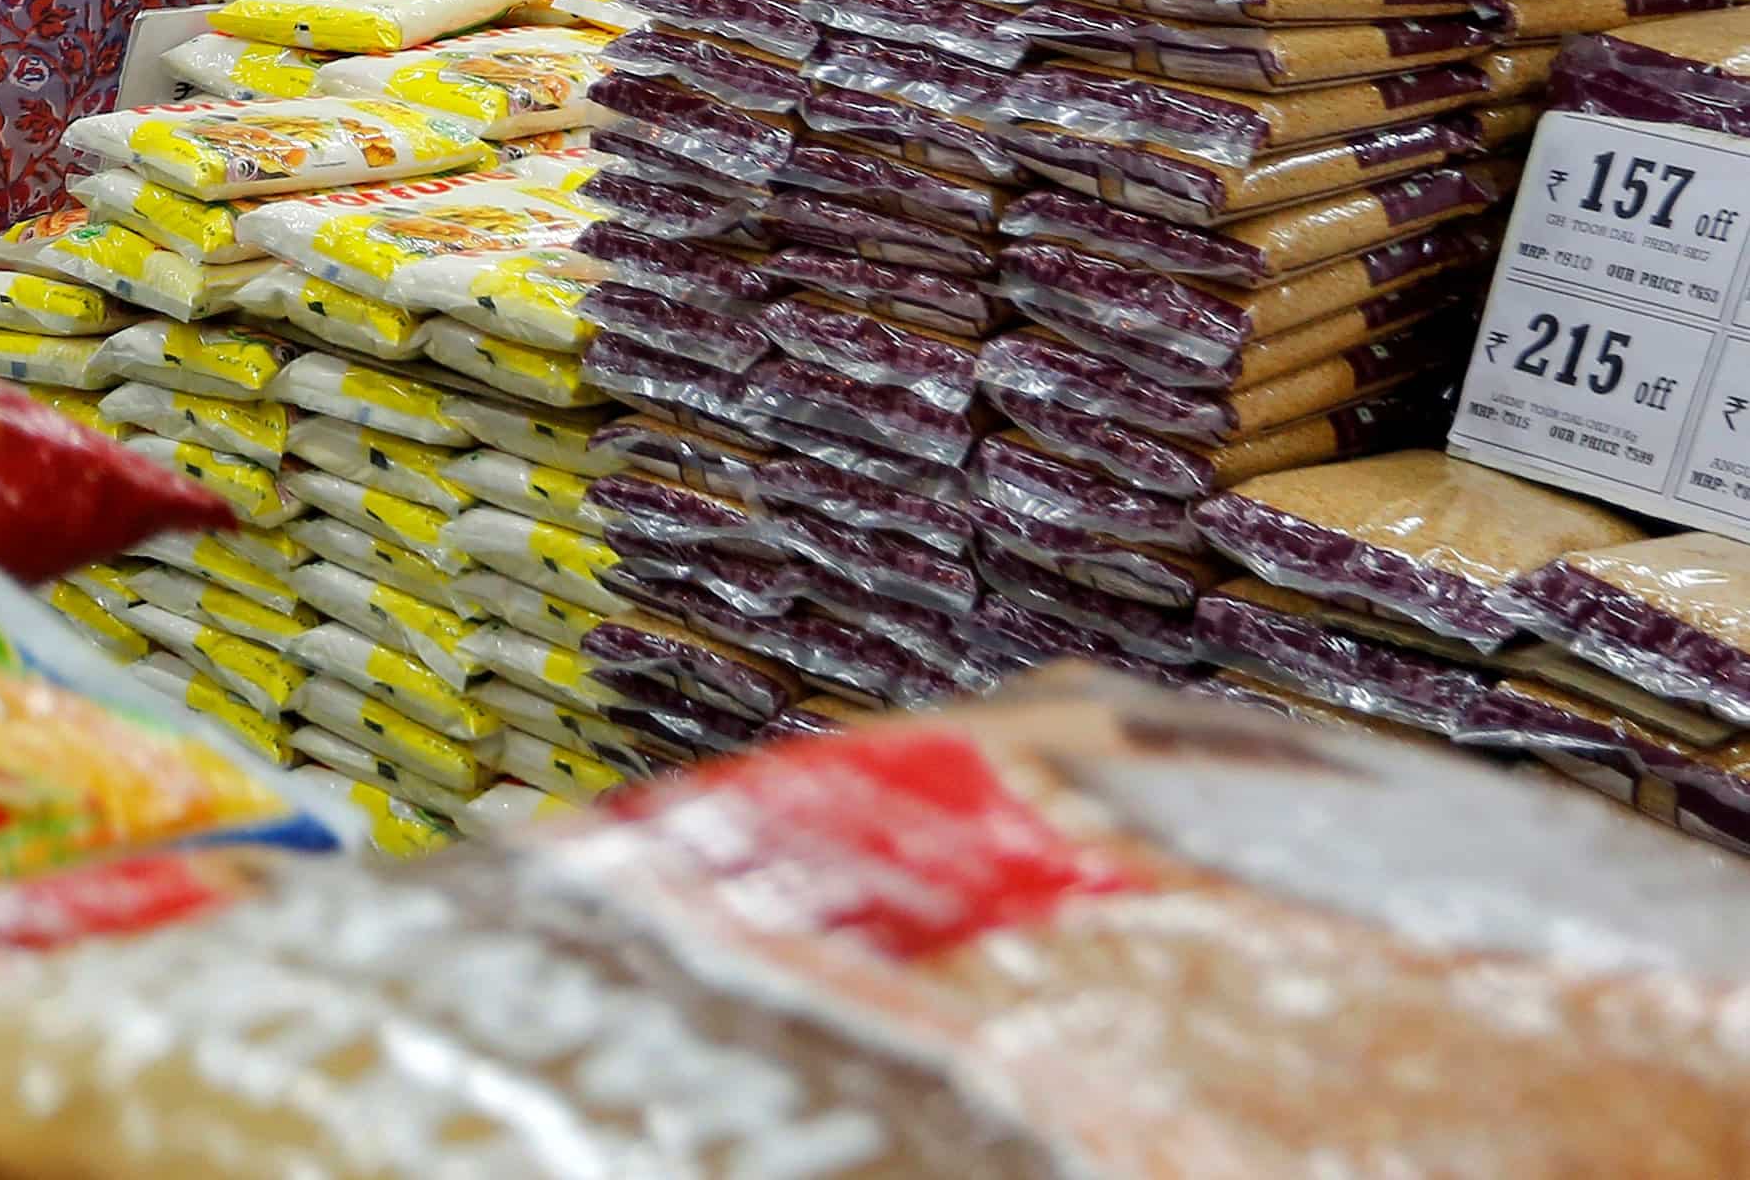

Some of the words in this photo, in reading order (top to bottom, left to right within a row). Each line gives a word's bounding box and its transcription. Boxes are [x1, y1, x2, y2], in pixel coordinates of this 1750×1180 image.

[1579, 151, 1696, 229] 157
[1695, 209, 1740, 243] off
[1610, 228, 1636, 245] DAL
[1518, 242, 1549, 261] MRP:
[1606, 264, 1635, 283] OUR
[1640, 272, 1683, 296] PRICE
[1513, 313, 1632, 396] 215
[1634, 376, 1678, 411] off
[1469, 401, 1498, 421] MRP:
[1549, 424, 1575, 444] OUR
[1579, 433, 1621, 457] PRICE
[1690, 470, 1728, 494] MRP:
